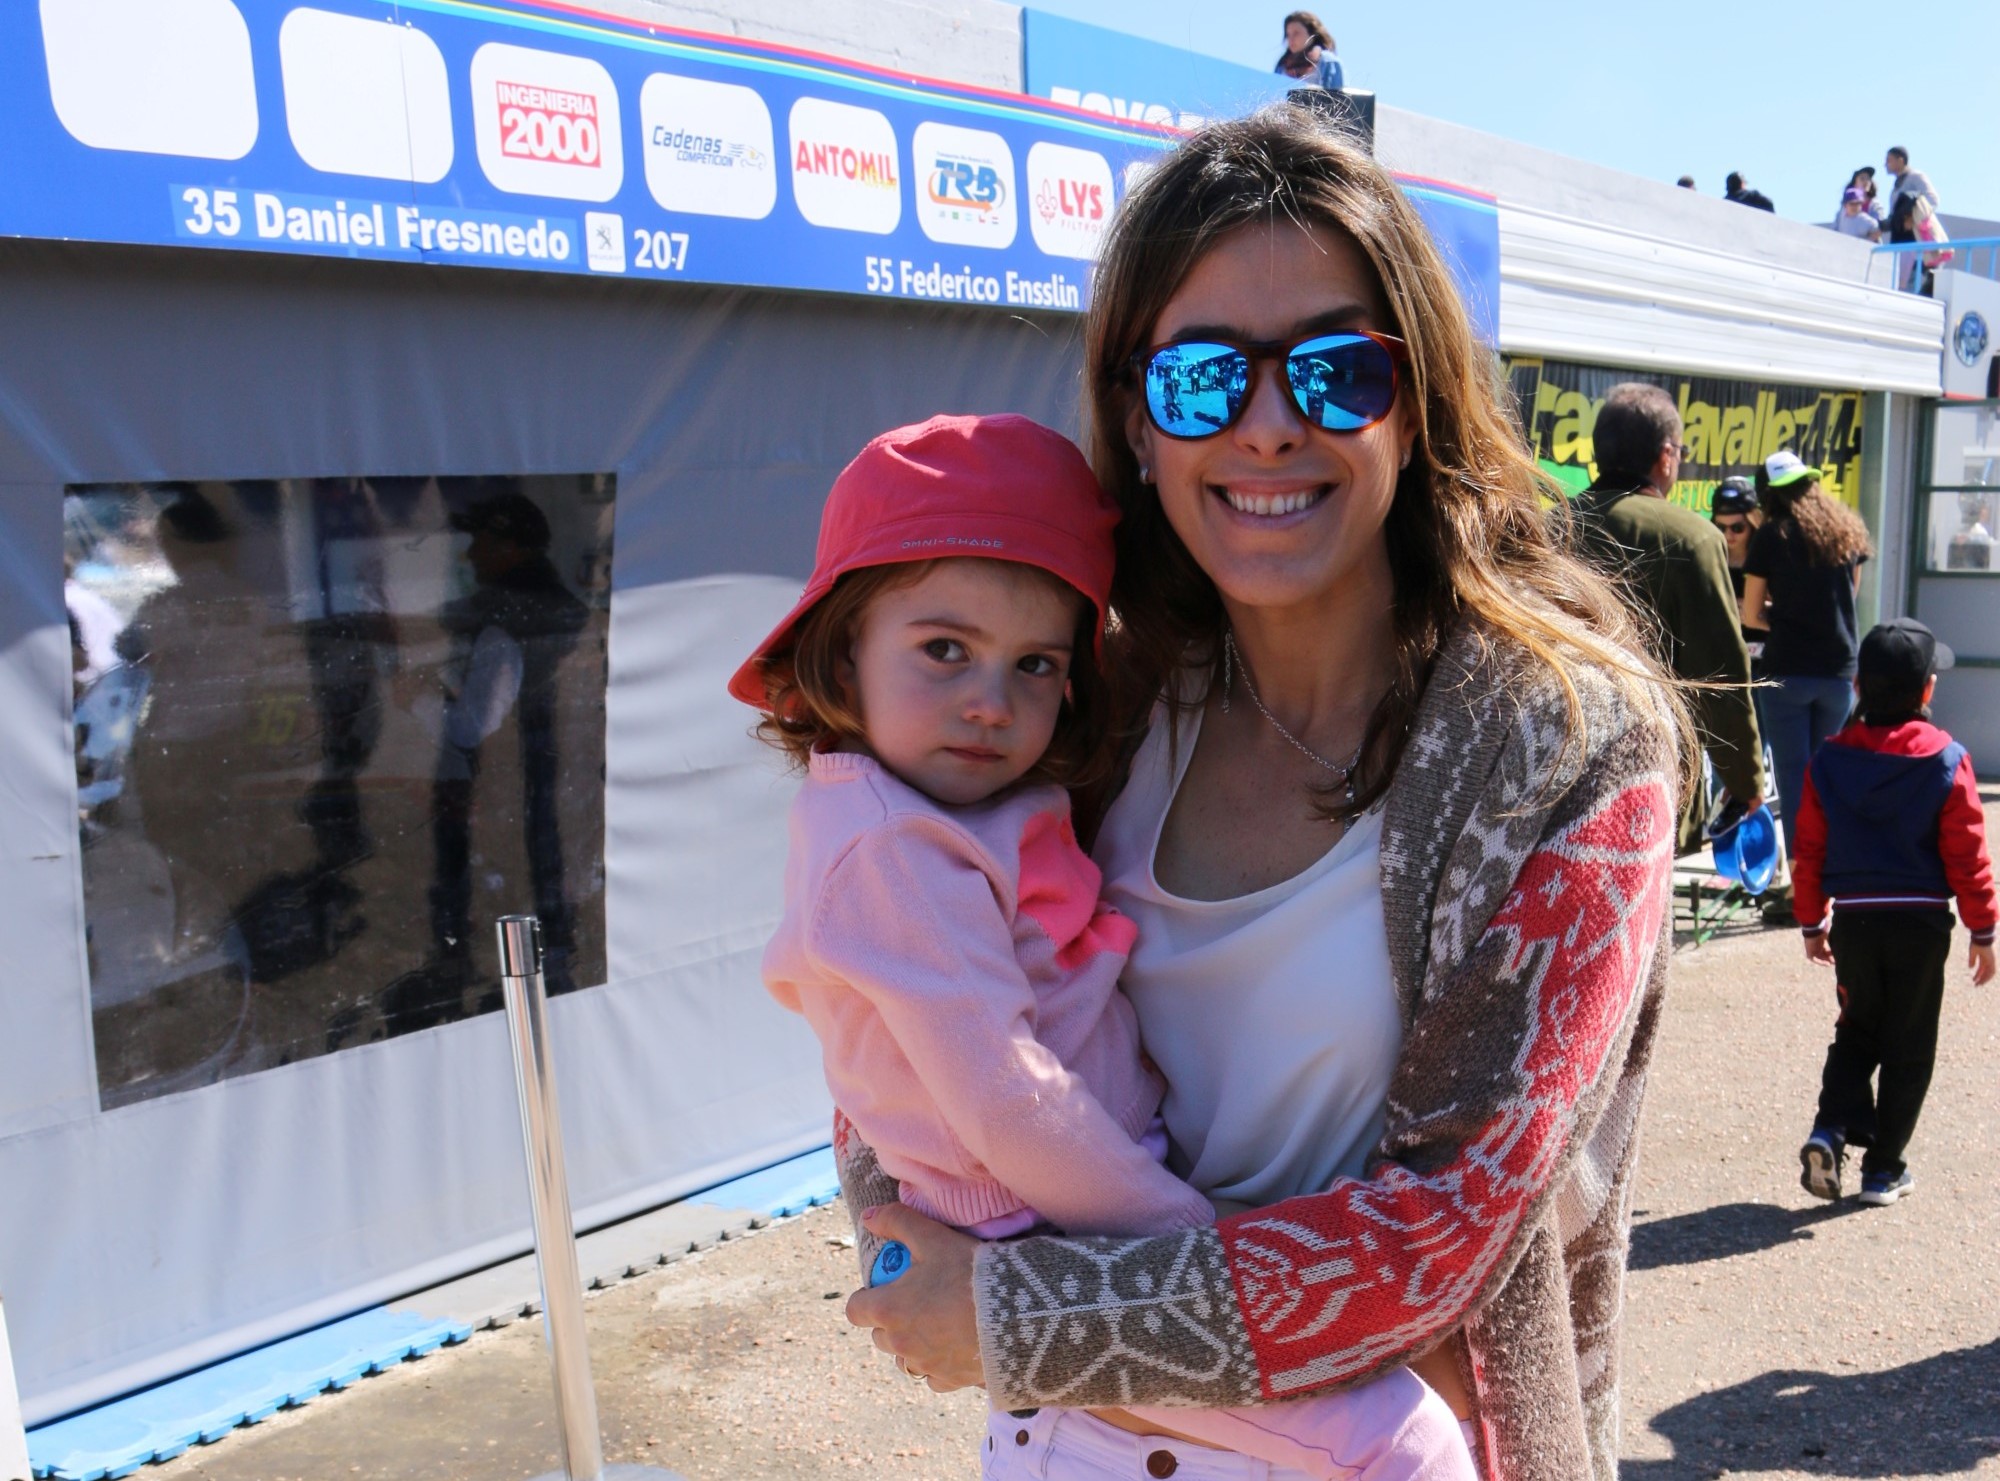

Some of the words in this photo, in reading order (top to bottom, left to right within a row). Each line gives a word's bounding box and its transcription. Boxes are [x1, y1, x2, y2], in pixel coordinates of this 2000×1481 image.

[497, 83, 596, 117] INGENIERIA
[502, 107, 599, 164] 2000
[652, 126, 722, 153] Cadenas
[676, 150, 734, 167] COMPETICION
[796, 140, 897, 186] ANTOMIL
[935, 159, 998, 203] TRB
[1058, 178, 1103, 220] LYS
[182, 187, 241, 237] 35
[254, 193, 386, 247] Daniel
[396, 206, 571, 261] Fresnedo
[634, 228, 690, 271] 207
[865, 256, 894, 293] 55
[900, 260, 1000, 302] Federico
[1005, 271, 1080, 309] Ensslin
[902, 537, 1004, 549] OMNI-SHADE
